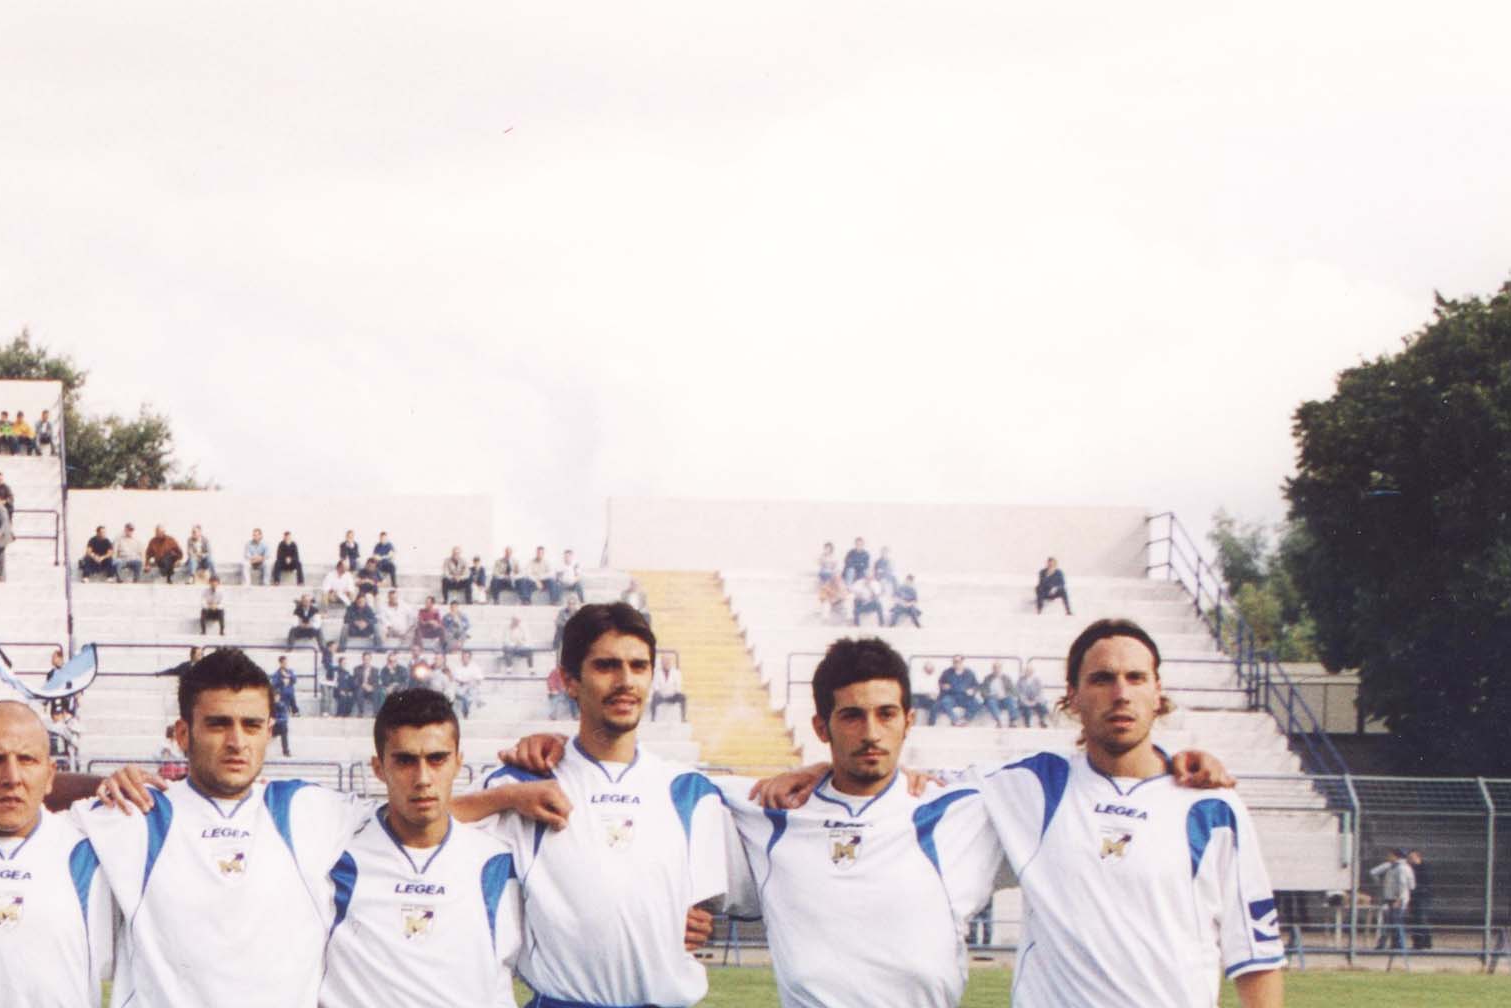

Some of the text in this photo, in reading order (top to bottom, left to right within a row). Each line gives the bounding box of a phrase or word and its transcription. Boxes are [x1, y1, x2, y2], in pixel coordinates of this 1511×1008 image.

[591, 794, 641, 805] LEGEA
[1094, 803, 1148, 820] LEGEA
[201, 827, 251, 839] LEGEA
[394, 883, 446, 896] LEGEA
